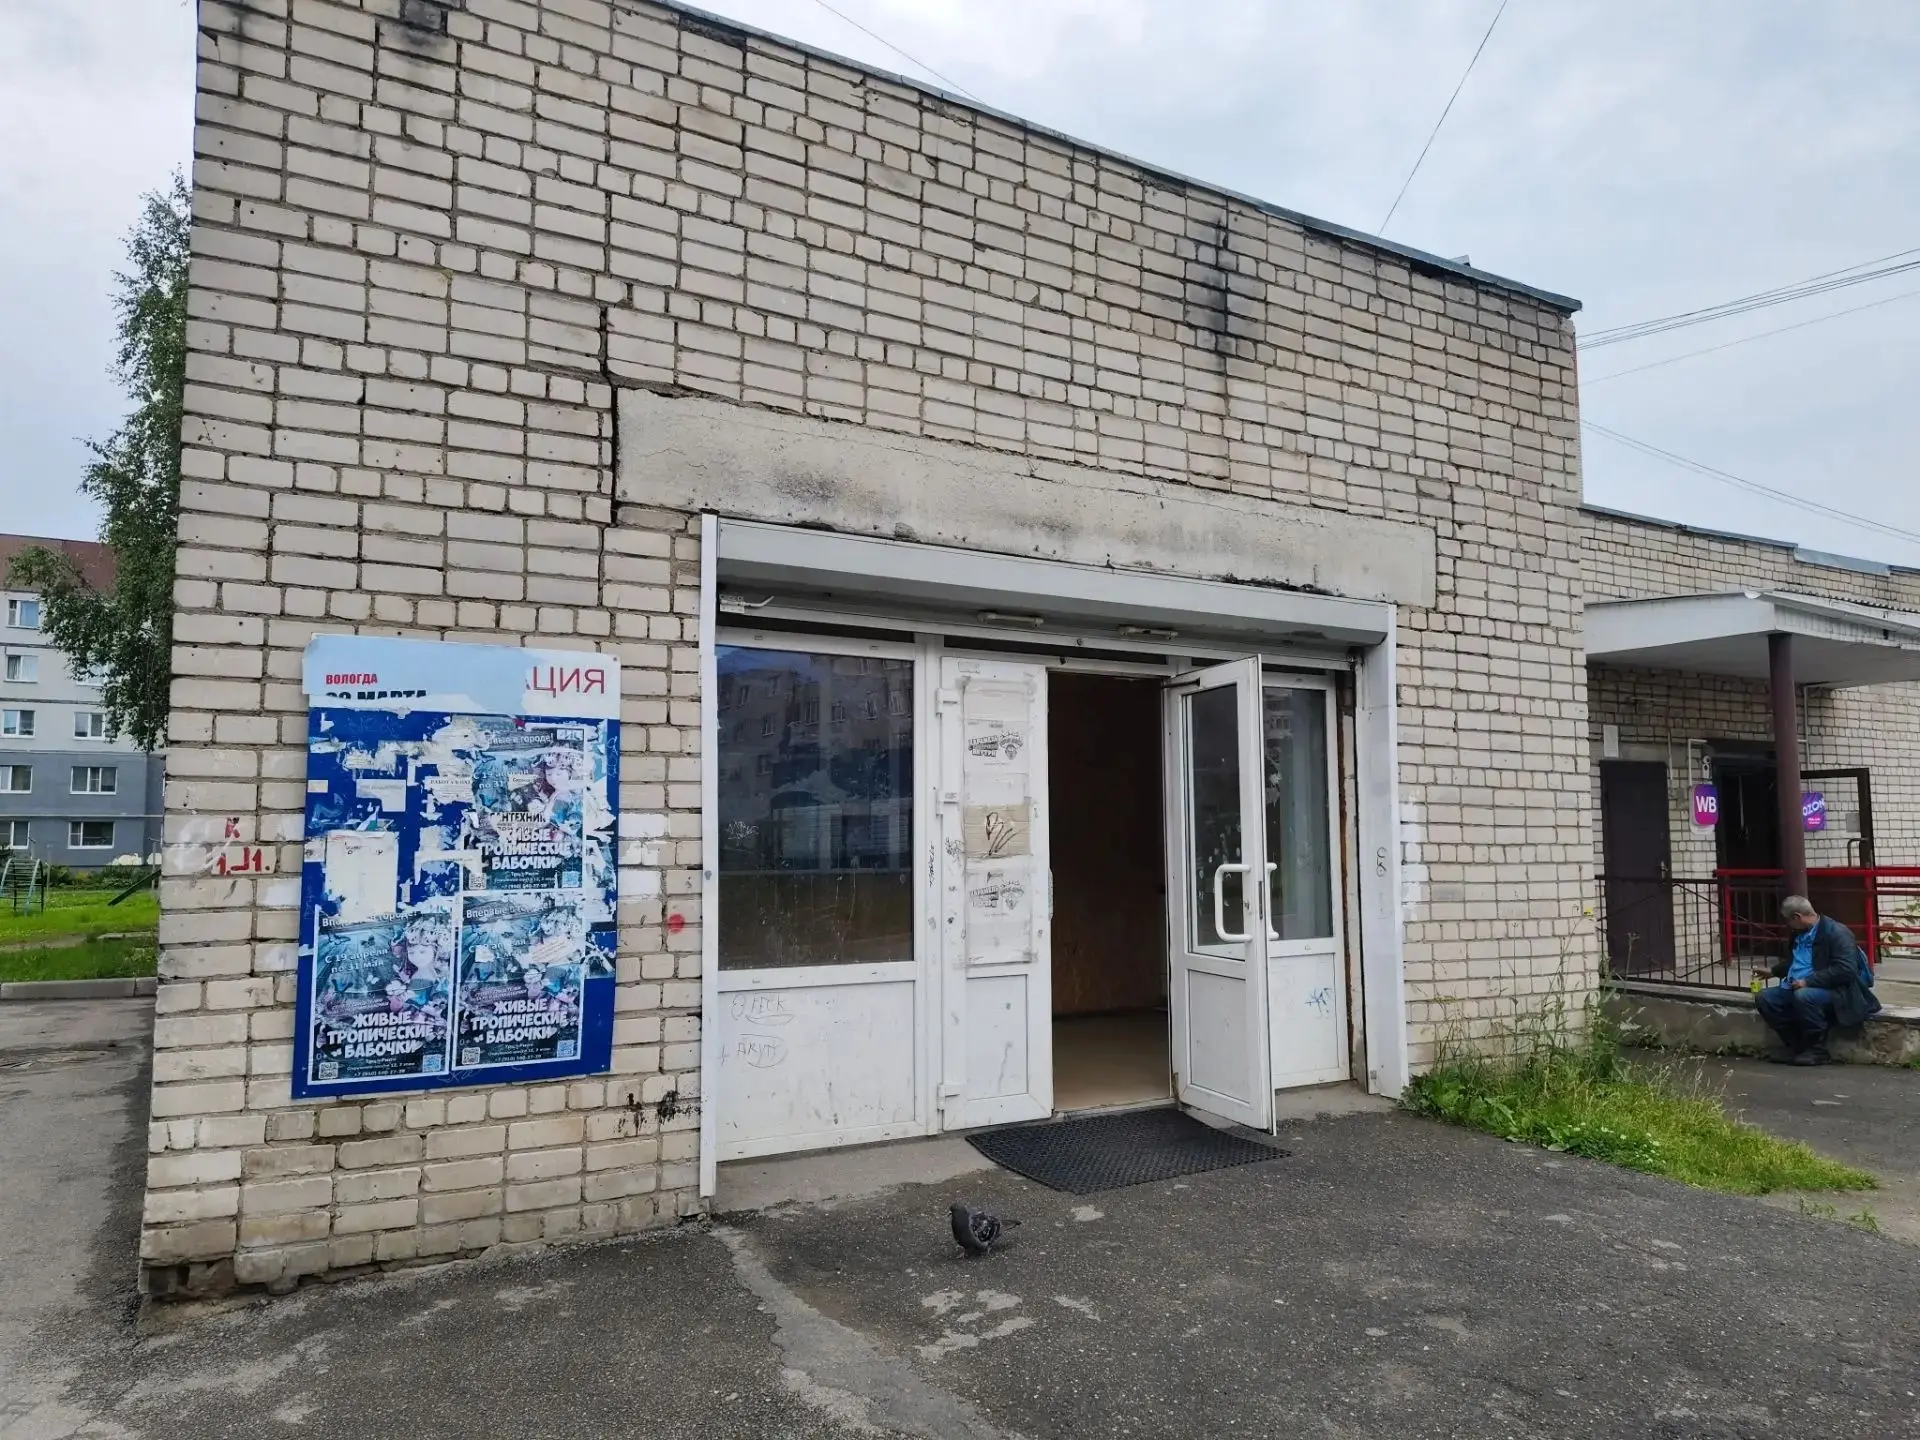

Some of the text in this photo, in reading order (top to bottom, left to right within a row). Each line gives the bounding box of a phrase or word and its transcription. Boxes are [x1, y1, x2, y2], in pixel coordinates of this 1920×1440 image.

[325, 673, 378, 685] ВОЛОГДА
[525, 666, 605, 698] ЦИЯ
[1695, 795, 1717, 813] WB
[1802, 798, 1825, 817] OZON
[491, 856, 558, 870] БАБОЧКИ
[336, 953, 347, 962] 19
[494, 998, 549, 1015] ЖИВЫЕ
[352, 1011, 413, 1028] ЖИВЫЕ
[470, 1011, 568, 1031] ТРОПИЧЕСКИЕ
[326, 1025, 434, 1045] ТРОПИЧЕСКИЕ
[486, 1026, 557, 1044] БАБОЧКИ
[344, 1040, 422, 1059] БАБОЧКИ
